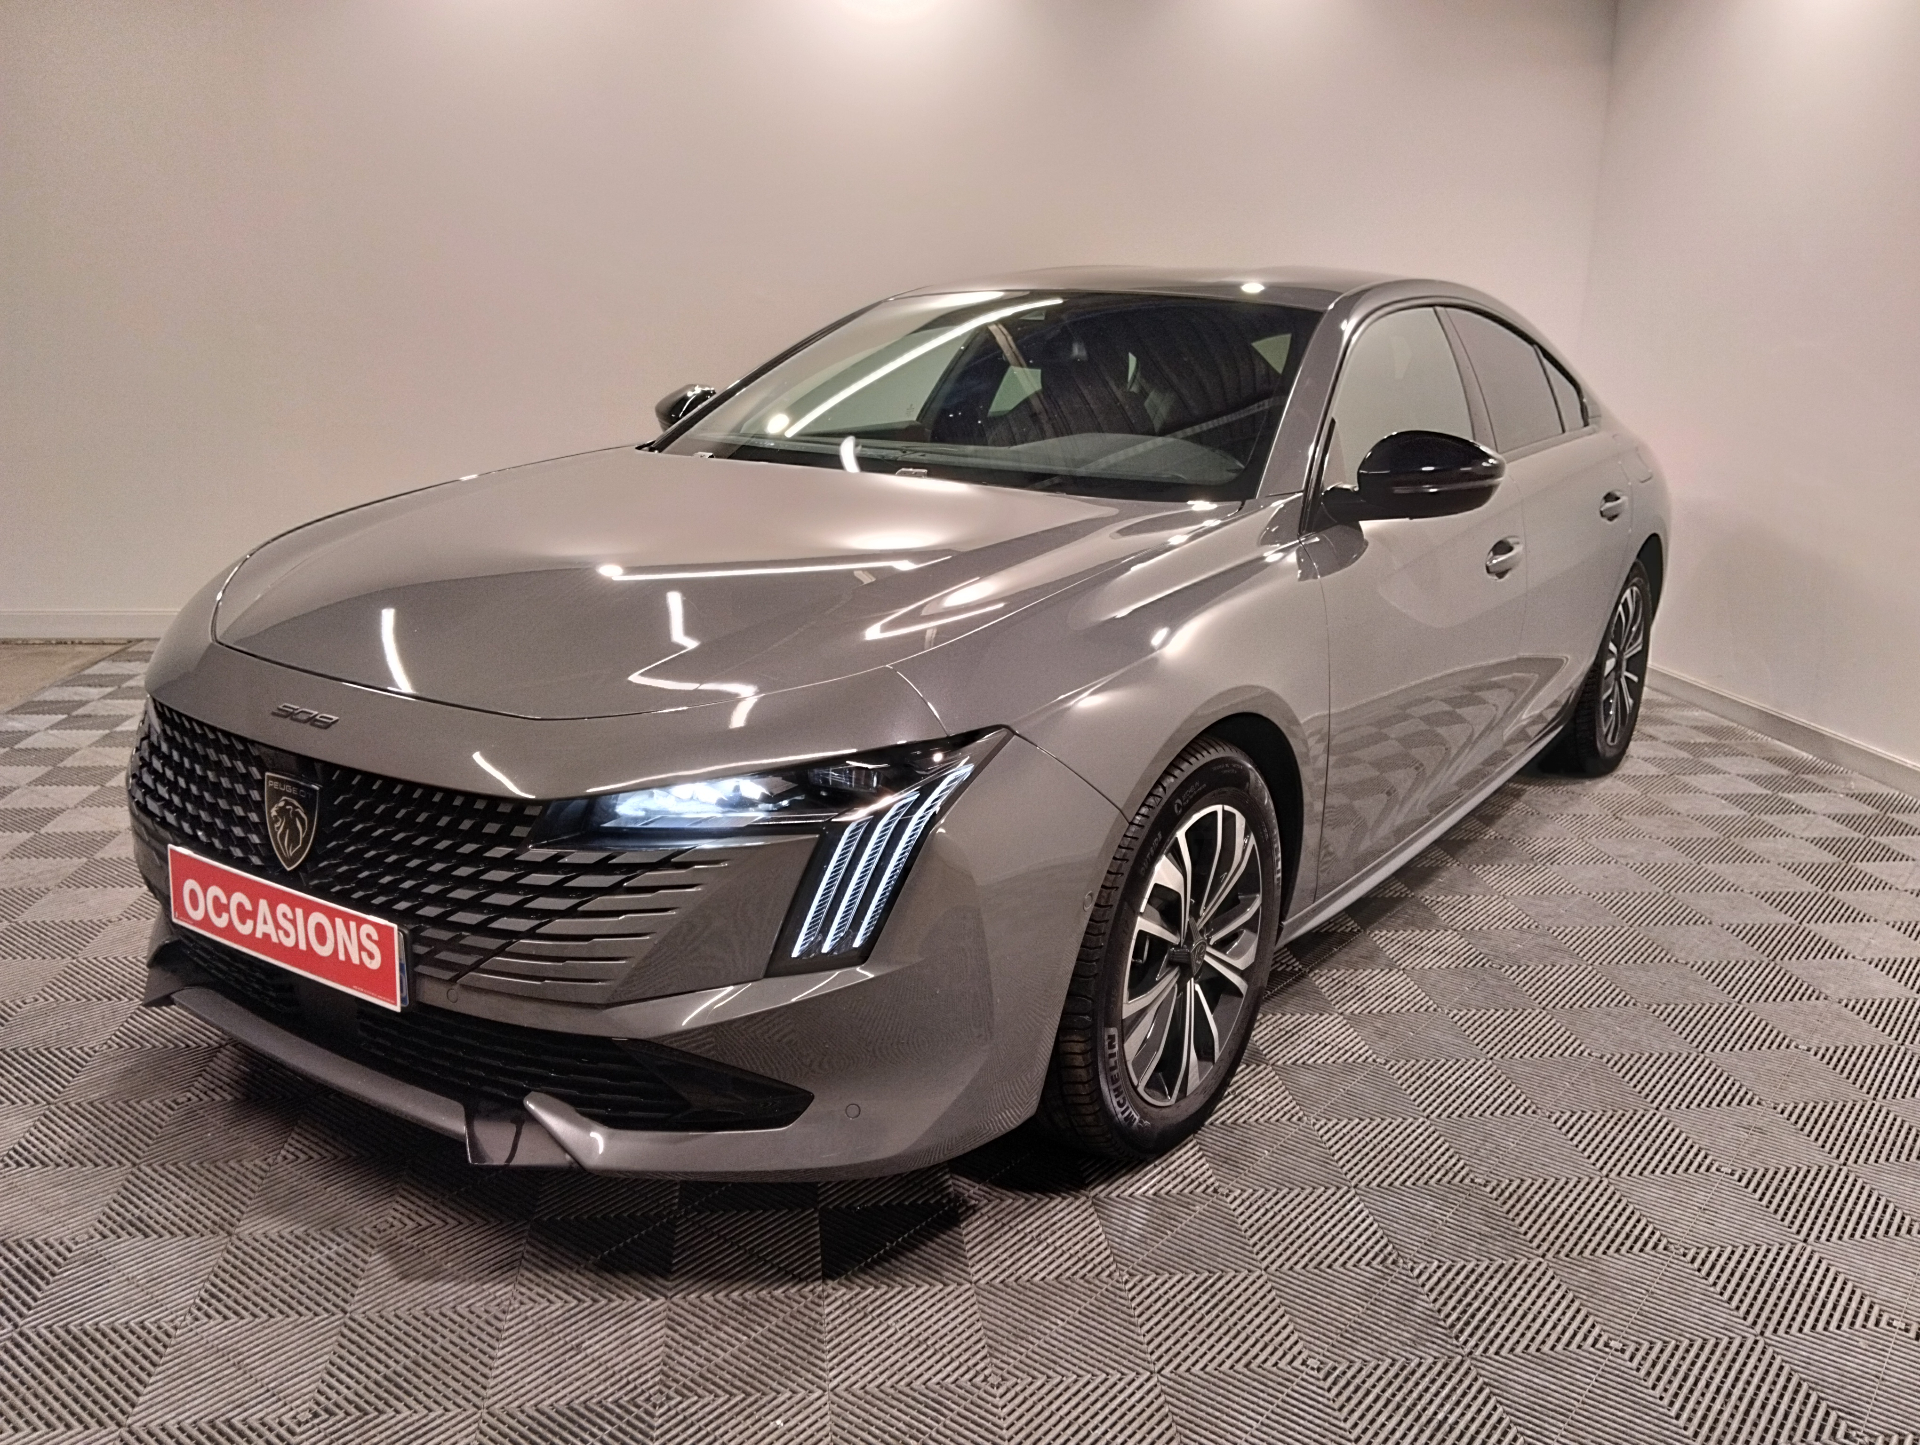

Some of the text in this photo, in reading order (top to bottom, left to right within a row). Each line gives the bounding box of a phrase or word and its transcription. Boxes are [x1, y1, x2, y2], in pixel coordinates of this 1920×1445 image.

[271, 703, 339, 730] 508
[268, 780, 312, 799] PEUGEOT
[183, 879, 381, 970] OCCASIONS
[1107, 1033, 1138, 1128] MICHELIN
